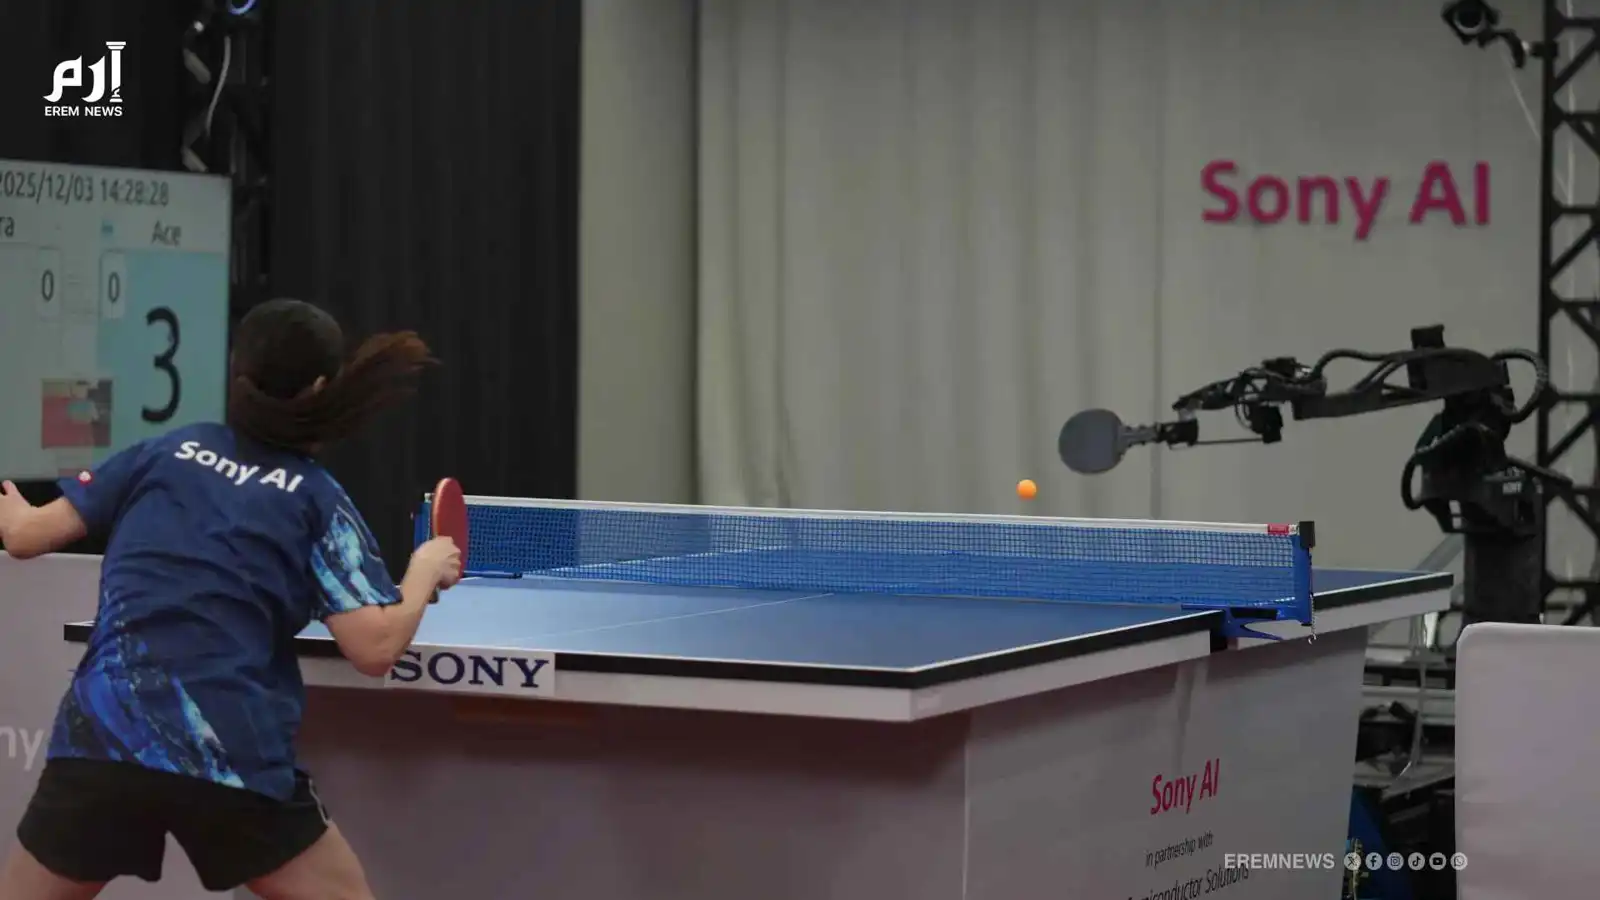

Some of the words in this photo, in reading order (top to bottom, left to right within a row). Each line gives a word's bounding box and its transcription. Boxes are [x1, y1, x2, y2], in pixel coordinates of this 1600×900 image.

[0, 168, 94, 205] 025/12/03
[1200, 159, 1391, 241] Sony
[1408, 159, 1491, 226] AI
[151, 219, 182, 246] Ace
[41, 269, 54, 302] 0
[108, 271, 121, 303] 0
[141, 306, 181, 423] 3
[174, 440, 260, 486] Sony
[259, 467, 304, 493] AI
[390, 650, 549, 688] SONY
[1150, 773, 1198, 815] Sony
[1199, 758, 1220, 800] AI
[1145, 850, 1154, 868] in
[1154, 838, 1196, 870] partnership
[1198, 830, 1214, 851] with
